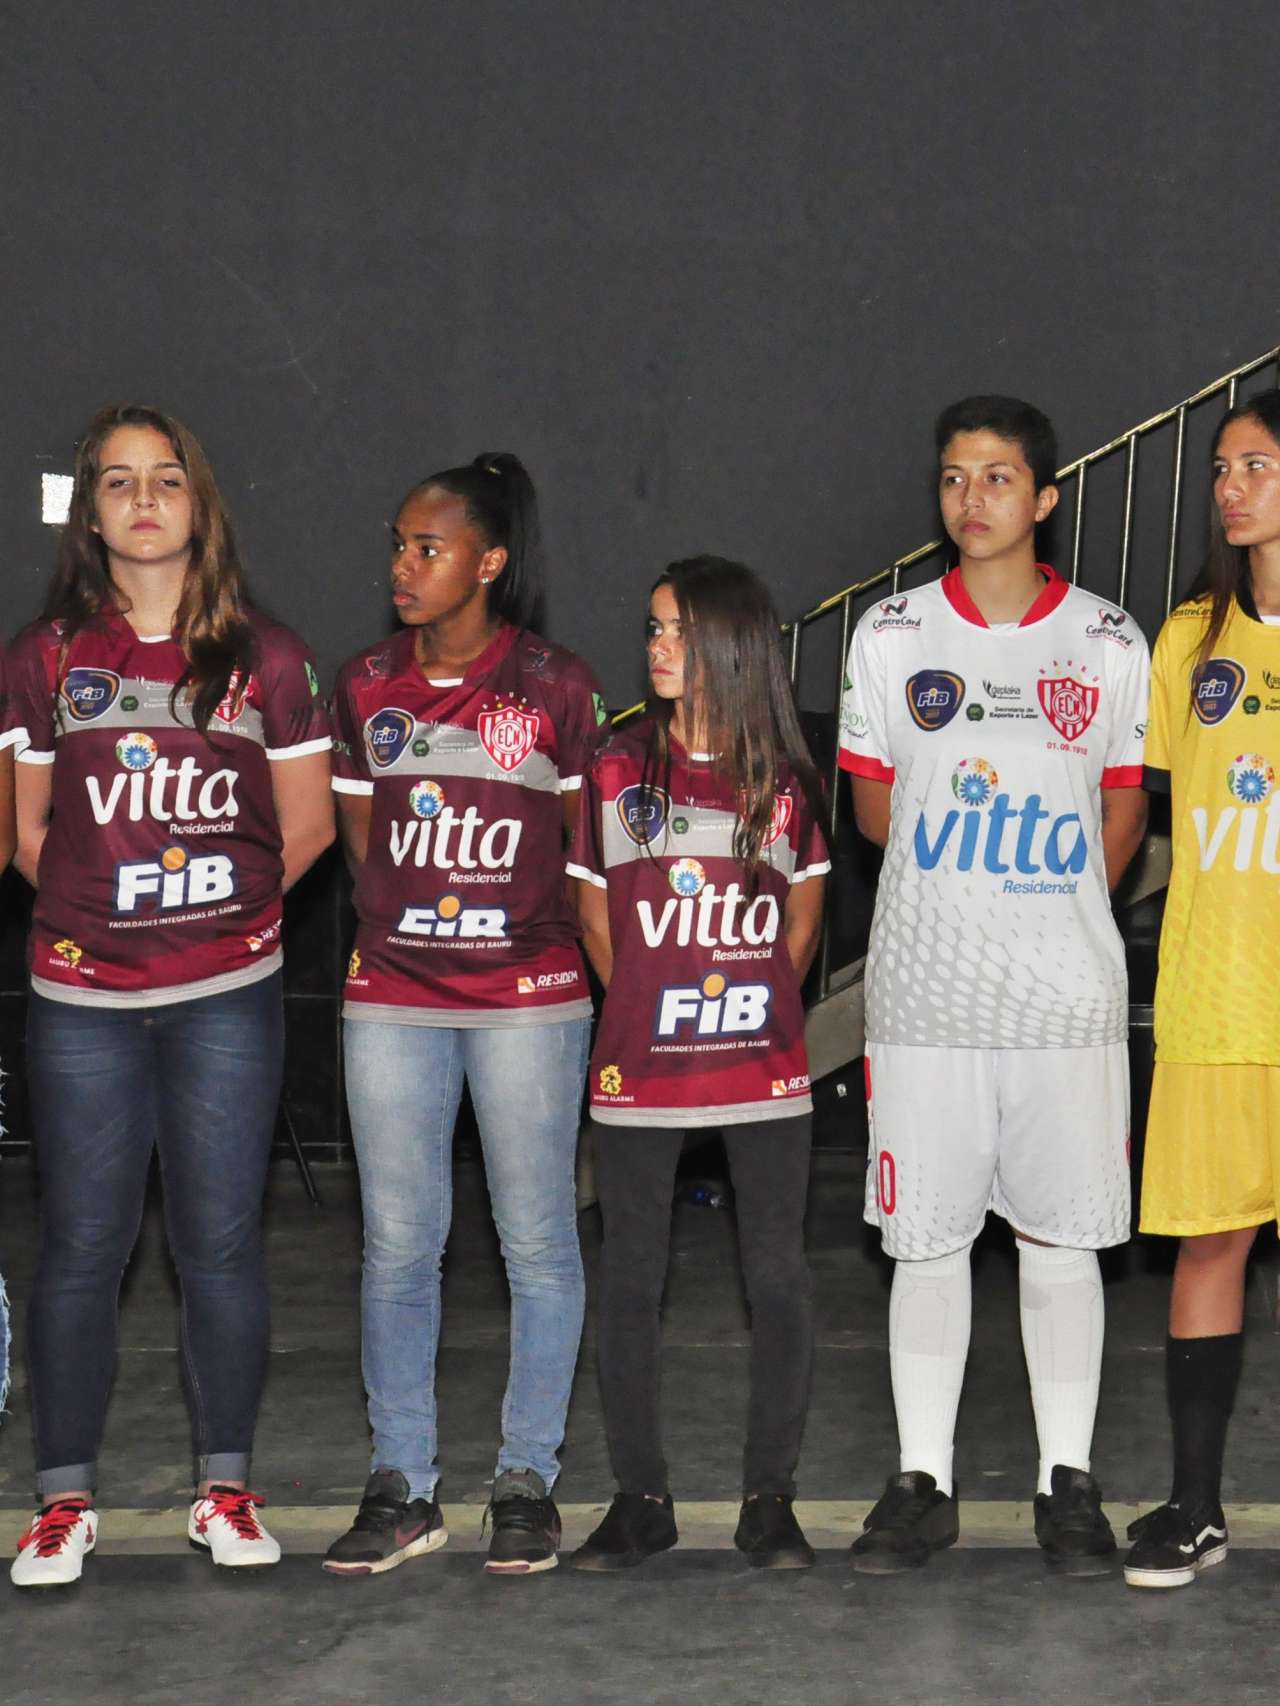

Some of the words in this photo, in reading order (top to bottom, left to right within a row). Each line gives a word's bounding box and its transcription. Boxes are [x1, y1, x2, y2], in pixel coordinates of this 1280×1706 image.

[85, 756, 239, 825] vitta
[169, 821, 235, 836] Residencial
[389, 806, 522, 869] vitta
[914, 793, 1087, 876] vitta
[448, 871, 512, 885] Residencial
[109, 918, 158, 930] FACULDADES
[159, 911, 206, 926] INTEGRADAS
[207, 908, 217, 918] DE
[636, 882, 779, 948] vitta
[386, 936, 429, 948] FACULDADES
[430, 941, 475, 950] INTEGRADAS
[476, 941, 486, 949] DE
[712, 947, 773, 962] Residencial
[650, 1044, 694, 1053] FACULDADES
[694, 1041, 737, 1052] INTEGRADAS
[738, 1041, 747, 1049] DE
